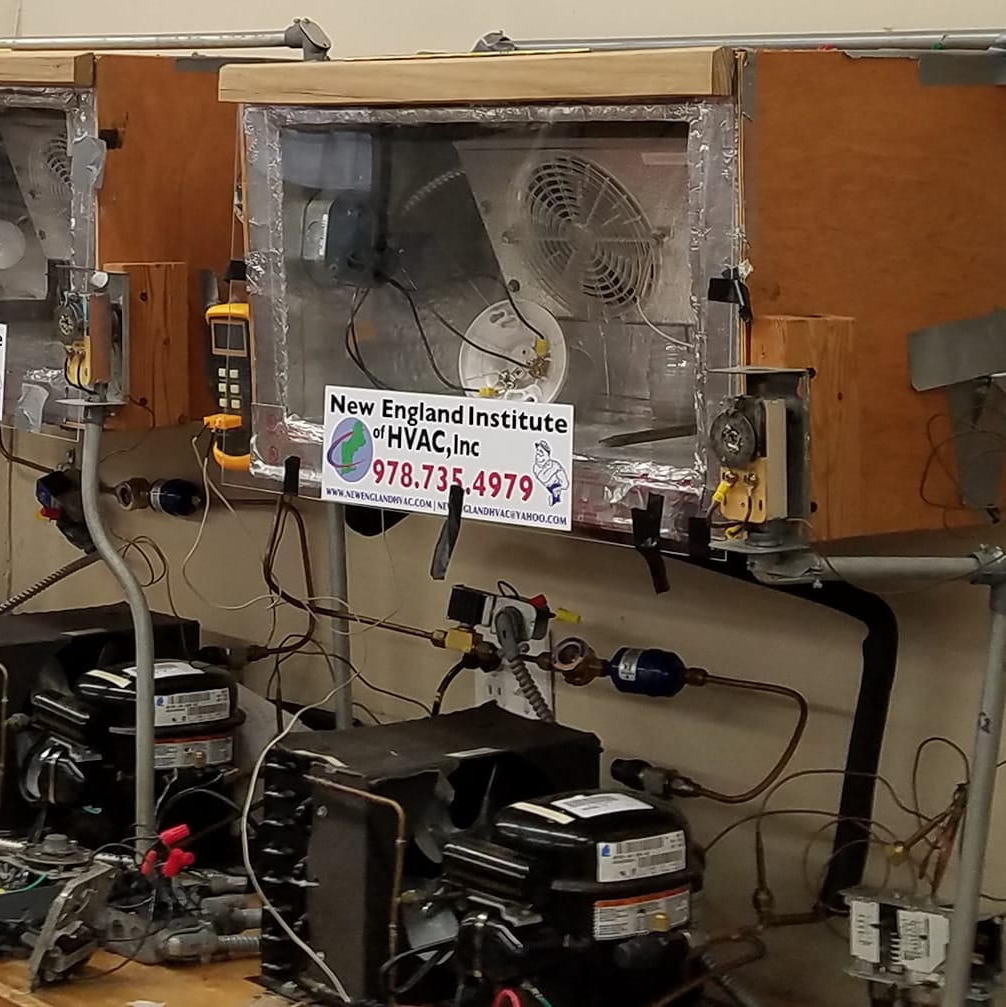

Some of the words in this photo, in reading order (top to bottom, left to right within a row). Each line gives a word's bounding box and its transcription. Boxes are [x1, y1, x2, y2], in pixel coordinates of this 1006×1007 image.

[330, 394, 375, 416] New
[382, 399, 463, 426] England
[469, 406, 568, 434] Institute
[373, 424, 385, 439] of
[372, 458, 534, 502] 978.735.4979
[325, 487, 433, 510] WWW.NEWENGLANDHVAC.COM
